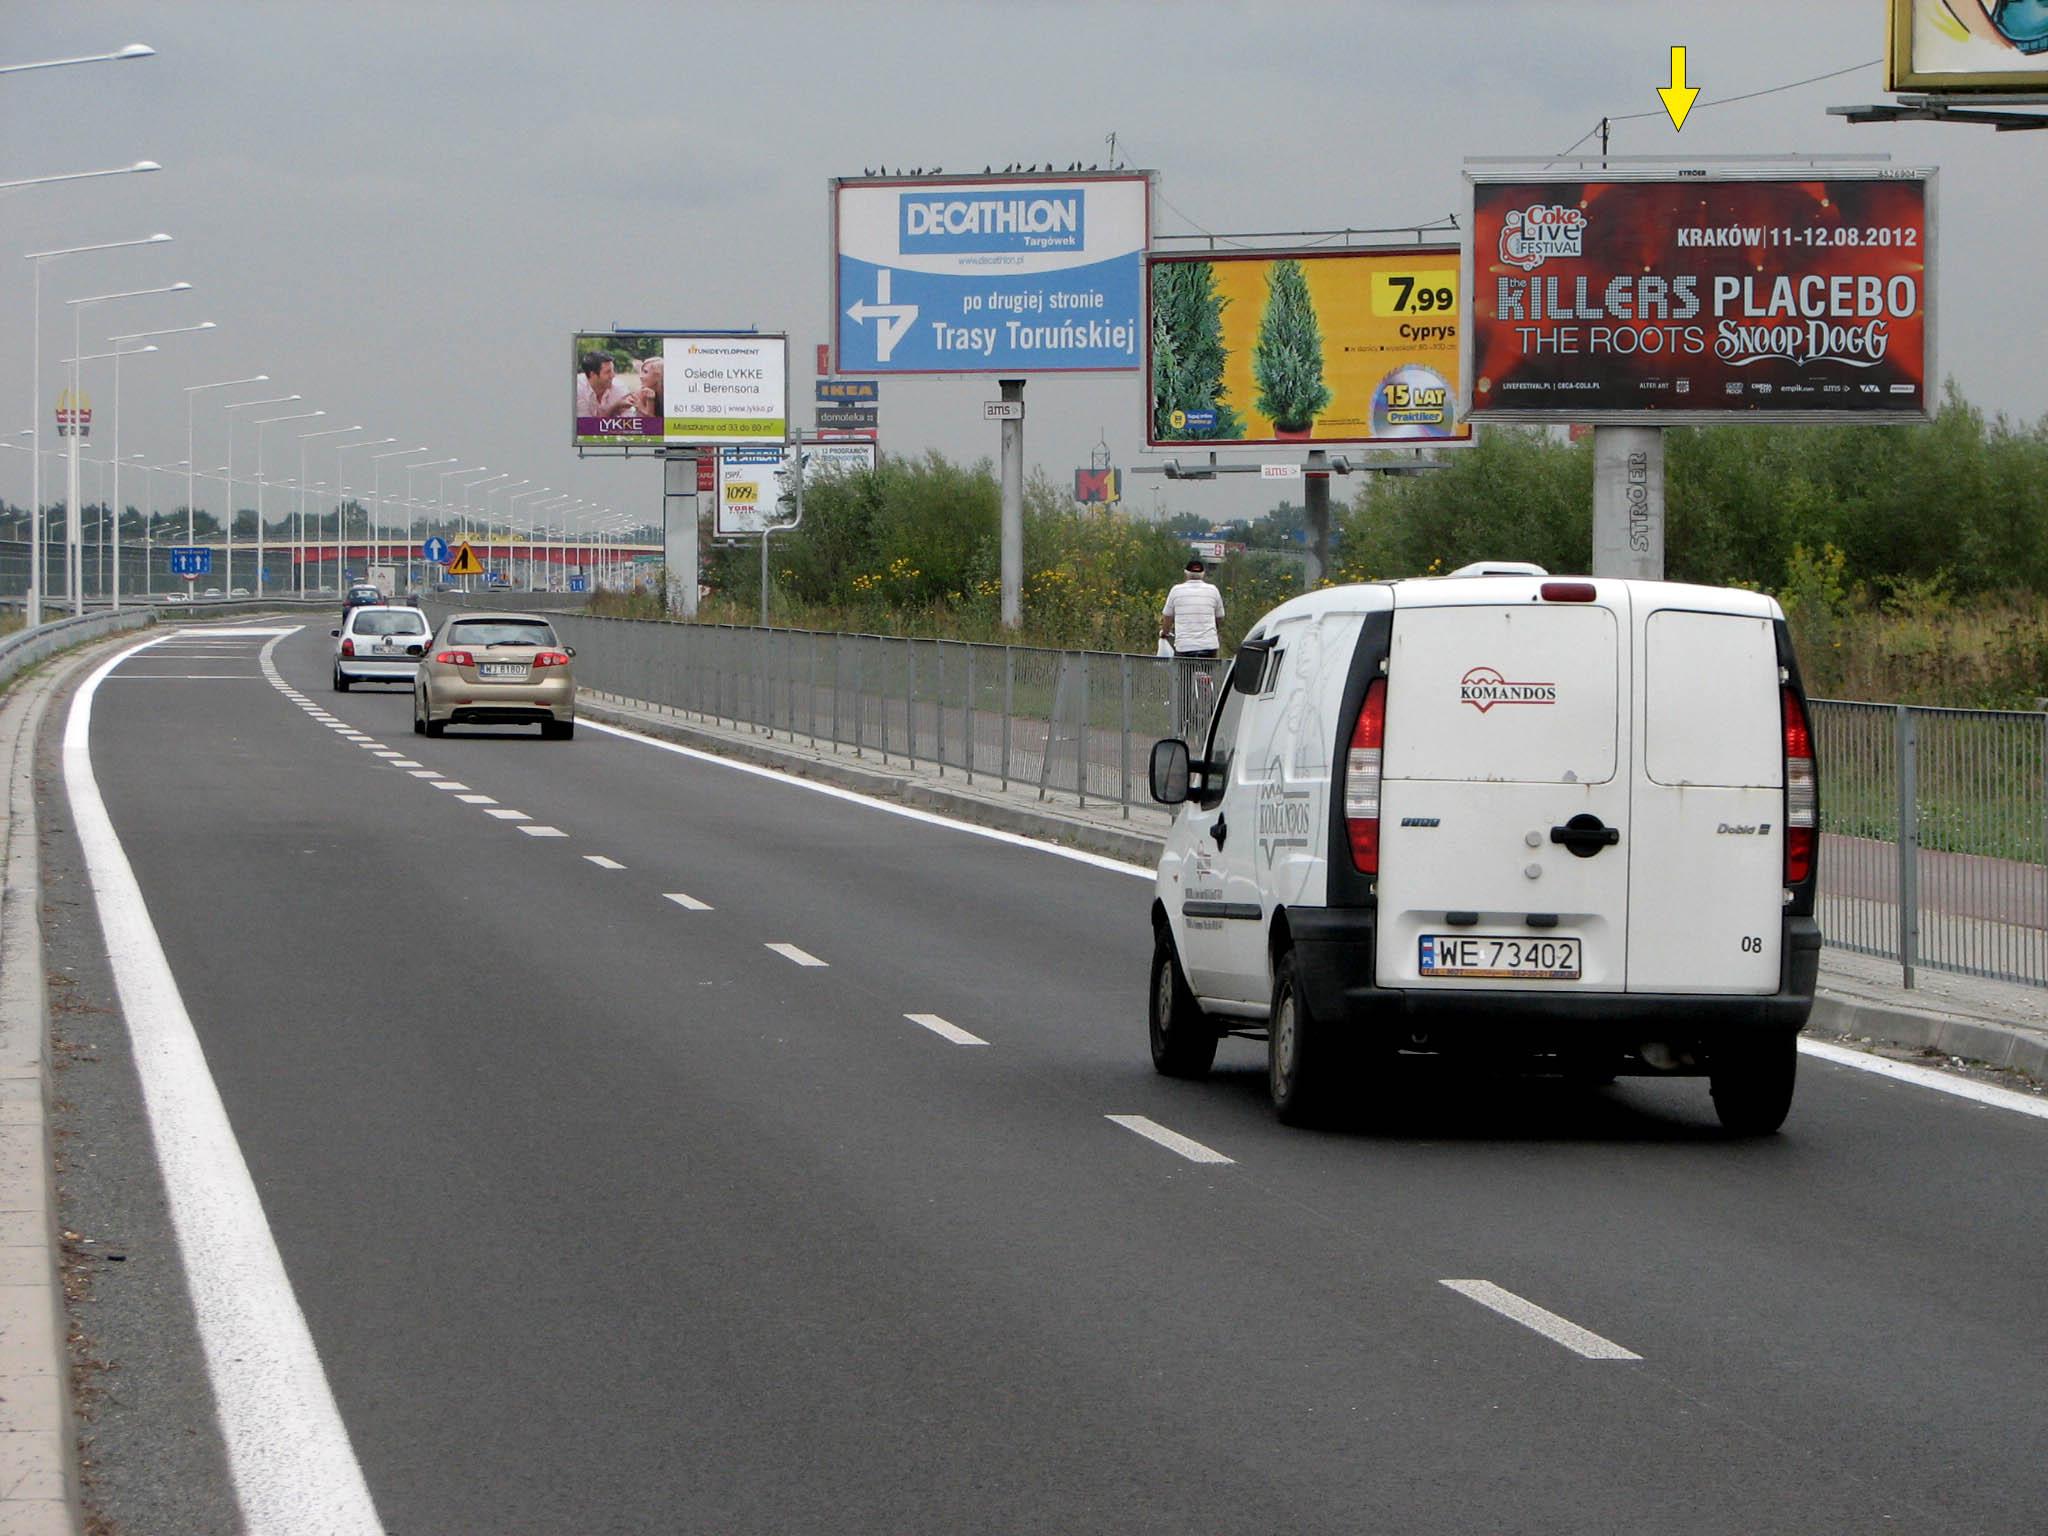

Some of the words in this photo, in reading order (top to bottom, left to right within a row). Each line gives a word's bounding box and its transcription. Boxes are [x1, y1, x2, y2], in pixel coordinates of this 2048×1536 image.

[907, 199, 1076, 235] DECATHLON
[1527, 207, 1579, 225] Coke
[1024, 235, 1076, 248] Targówek
[1677, 223, 1761, 247] KRAKÓW
[1770, 227, 1917, 247] 11-12.08.2012
[1520, 242, 1580, 254] FESTIVAL
[958, 255, 1025, 266] www.decathlon.pl
[1509, 279, 1527, 288] the
[963, 293, 982, 314] po
[988, 290, 1044, 313] drugiej
[1049, 289, 1104, 308] stronie
[1388, 276, 1454, 314] 7,99
[1713, 275, 1917, 318] PLACEBO
[932, 322, 998, 355] Trasy
[1005, 318, 1135, 355] Toruńskiej
[1399, 323, 1456, 341] Cyprys
[1515, 326, 1580, 354] THE
[1590, 326, 1705, 354] ROOTS
[684, 368, 724, 379] Osiedle
[727, 369, 764, 379] LYKKE
[688, 383, 700, 393] ul.
[703, 382, 760, 393] Berensona
[821, 385, 873, 396] IKEA
[1384, 384, 1411, 407] 15
[1414, 388, 1446, 407] LAT
[821, 412, 865, 422] domoteka
[987, 405, 1010, 416] ams
[1391, 412, 1440, 421] Praktiker
[599, 418, 643, 432] LYKKE
[1264, 467, 1288, 477] ams
[1626, 451, 1650, 553] STRÖER
[1460, 686, 1557, 700] KOMANDOS
[1259, 803, 1310, 834] KOMANDOS
[1741, 936, 1762, 953] 08
[1440, 940, 1479, 967] WE
[1489, 941, 1574, 969] 73402
